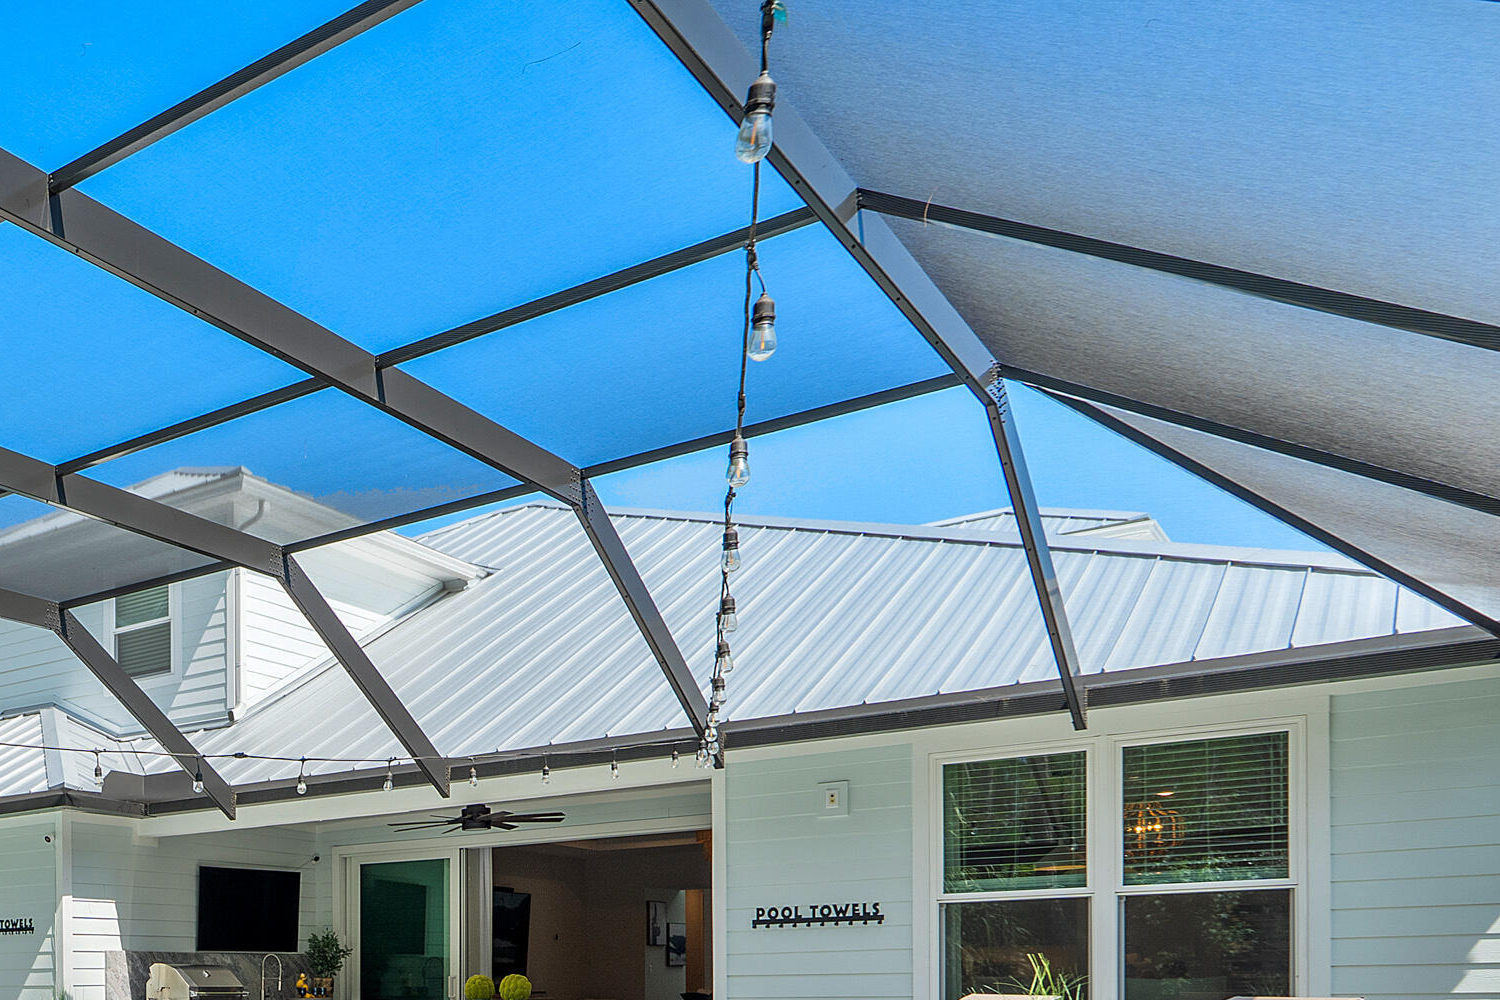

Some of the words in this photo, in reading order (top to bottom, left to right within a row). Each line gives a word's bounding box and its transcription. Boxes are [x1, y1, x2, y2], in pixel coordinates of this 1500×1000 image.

[756, 906, 802, 920] POOL
[809, 902, 880, 918] TOWELS
[0, 918, 33, 929] TOWELS
